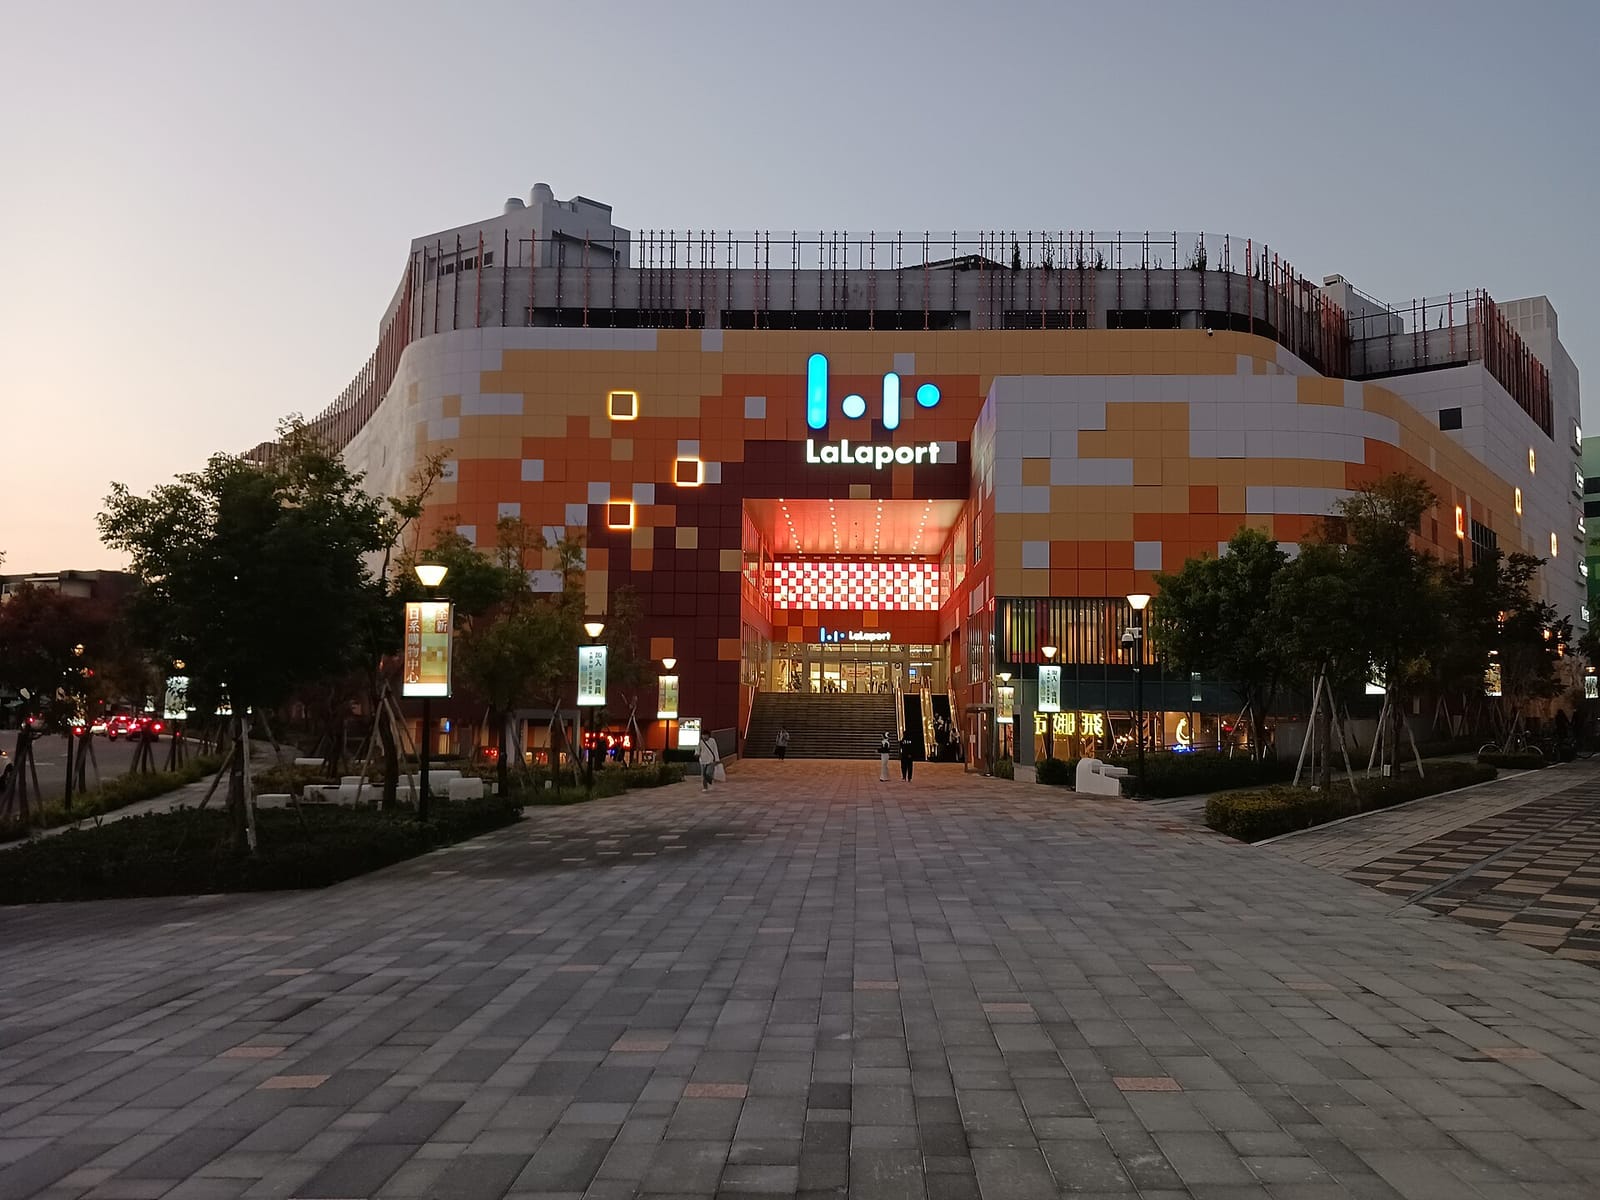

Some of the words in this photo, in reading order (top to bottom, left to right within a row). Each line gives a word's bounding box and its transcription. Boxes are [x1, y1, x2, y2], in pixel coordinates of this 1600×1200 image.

[806, 438, 940, 470] LaLaport
[406, 607, 420, 684] 日系購物中心
[848, 630, 892, 643] LaLaport
